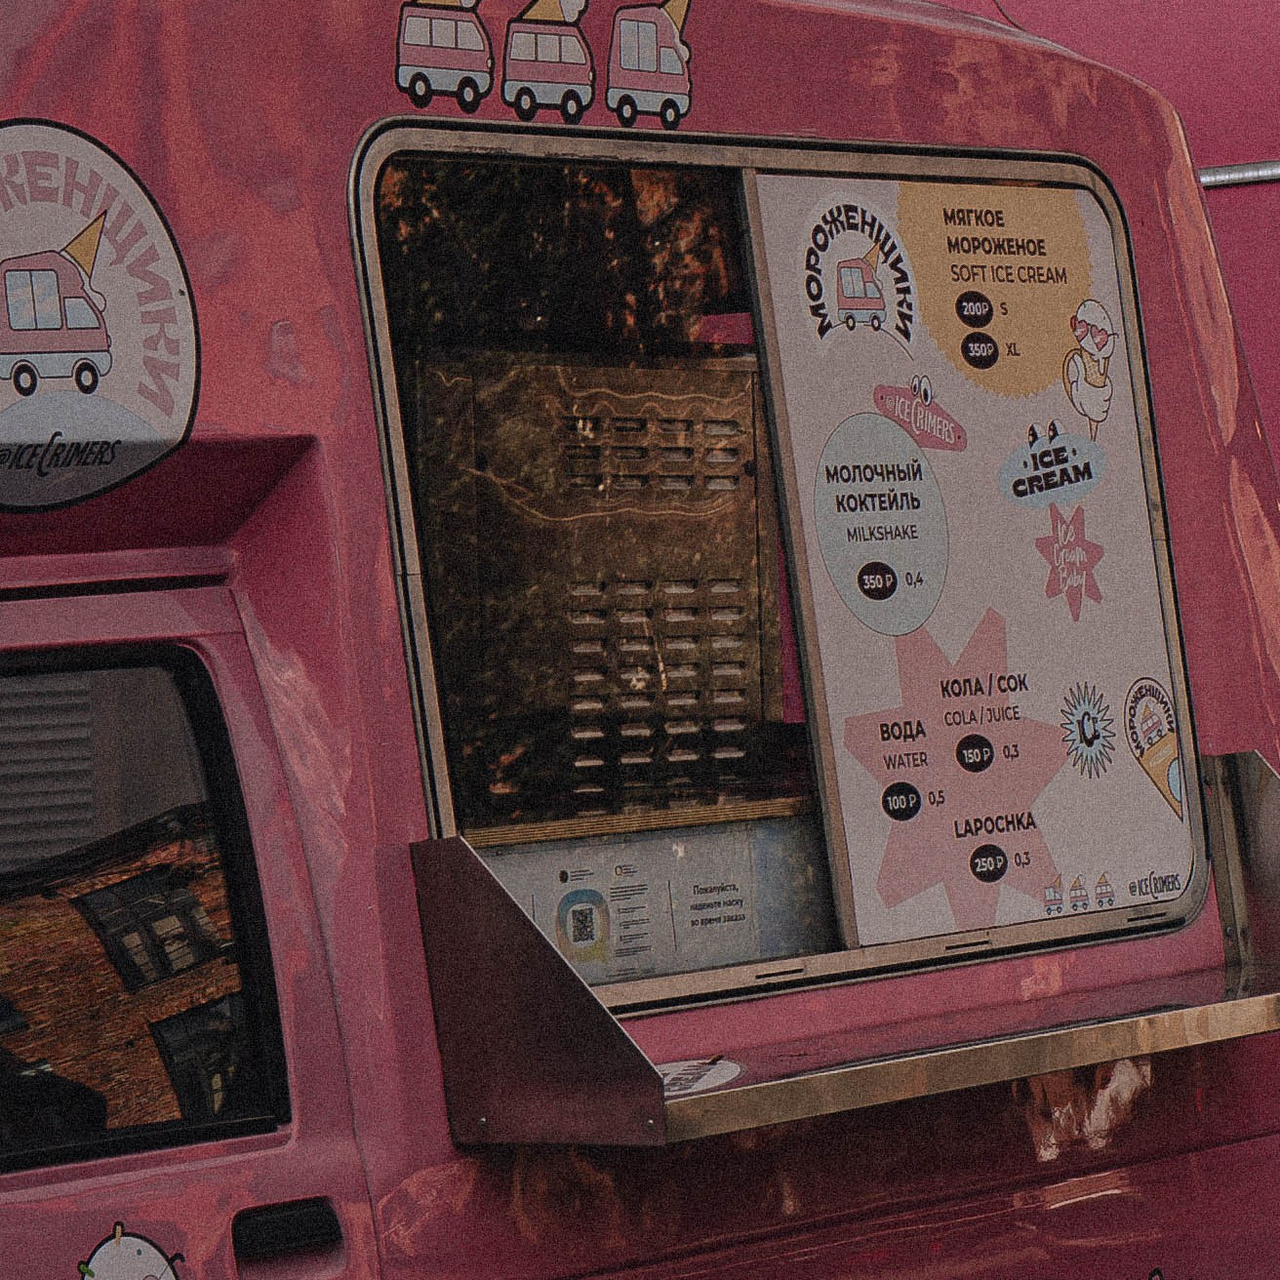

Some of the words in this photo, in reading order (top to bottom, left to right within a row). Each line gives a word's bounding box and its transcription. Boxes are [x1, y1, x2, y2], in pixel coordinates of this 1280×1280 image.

[943, 208, 1005, 227] МЯГКОЕ
[947, 236, 1046, 256] МОРОЖЕНОЕ
[805, 204, 915, 340] МОРОЖЕНЩИКИ
[951, 264, 986, 282] SOFT
[991, 265, 1015, 283] ICE
[1017, 266, 1067, 284] CREAM
[999, 302, 1008, 316] S
[1005, 342, 1021, 357] XL
[1030, 446, 1068, 472] ICE
[825, 458, 923, 484] МОЛОЧНЫЙ
[1012, 462, 1093, 498] CREAM
[835, 488, 921, 513] КОКТЕЙЛЬ
[846, 524, 919, 542] MILKSHAKE
[1056, 518, 1077, 546] Ice
[905, 572, 924, 588] 0,4
[1058, 565, 1087, 595] Baby
[940, 677, 985, 698] КОЛА
[997, 673, 1029, 693] СОК
[944, 710, 977, 727] COLA
[986, 705, 1021, 723] JUICE
[879, 720, 926, 742] ВОДА
[1076, 711, 1100, 748] ICE
[883, 751, 929, 770] WATER
[1002, 744, 1020, 760] 0,3
[928, 790, 945, 806] 0,5
[954, 811, 1037, 839] LAPOCHKA
[1014, 851, 1031, 868] 0,3
